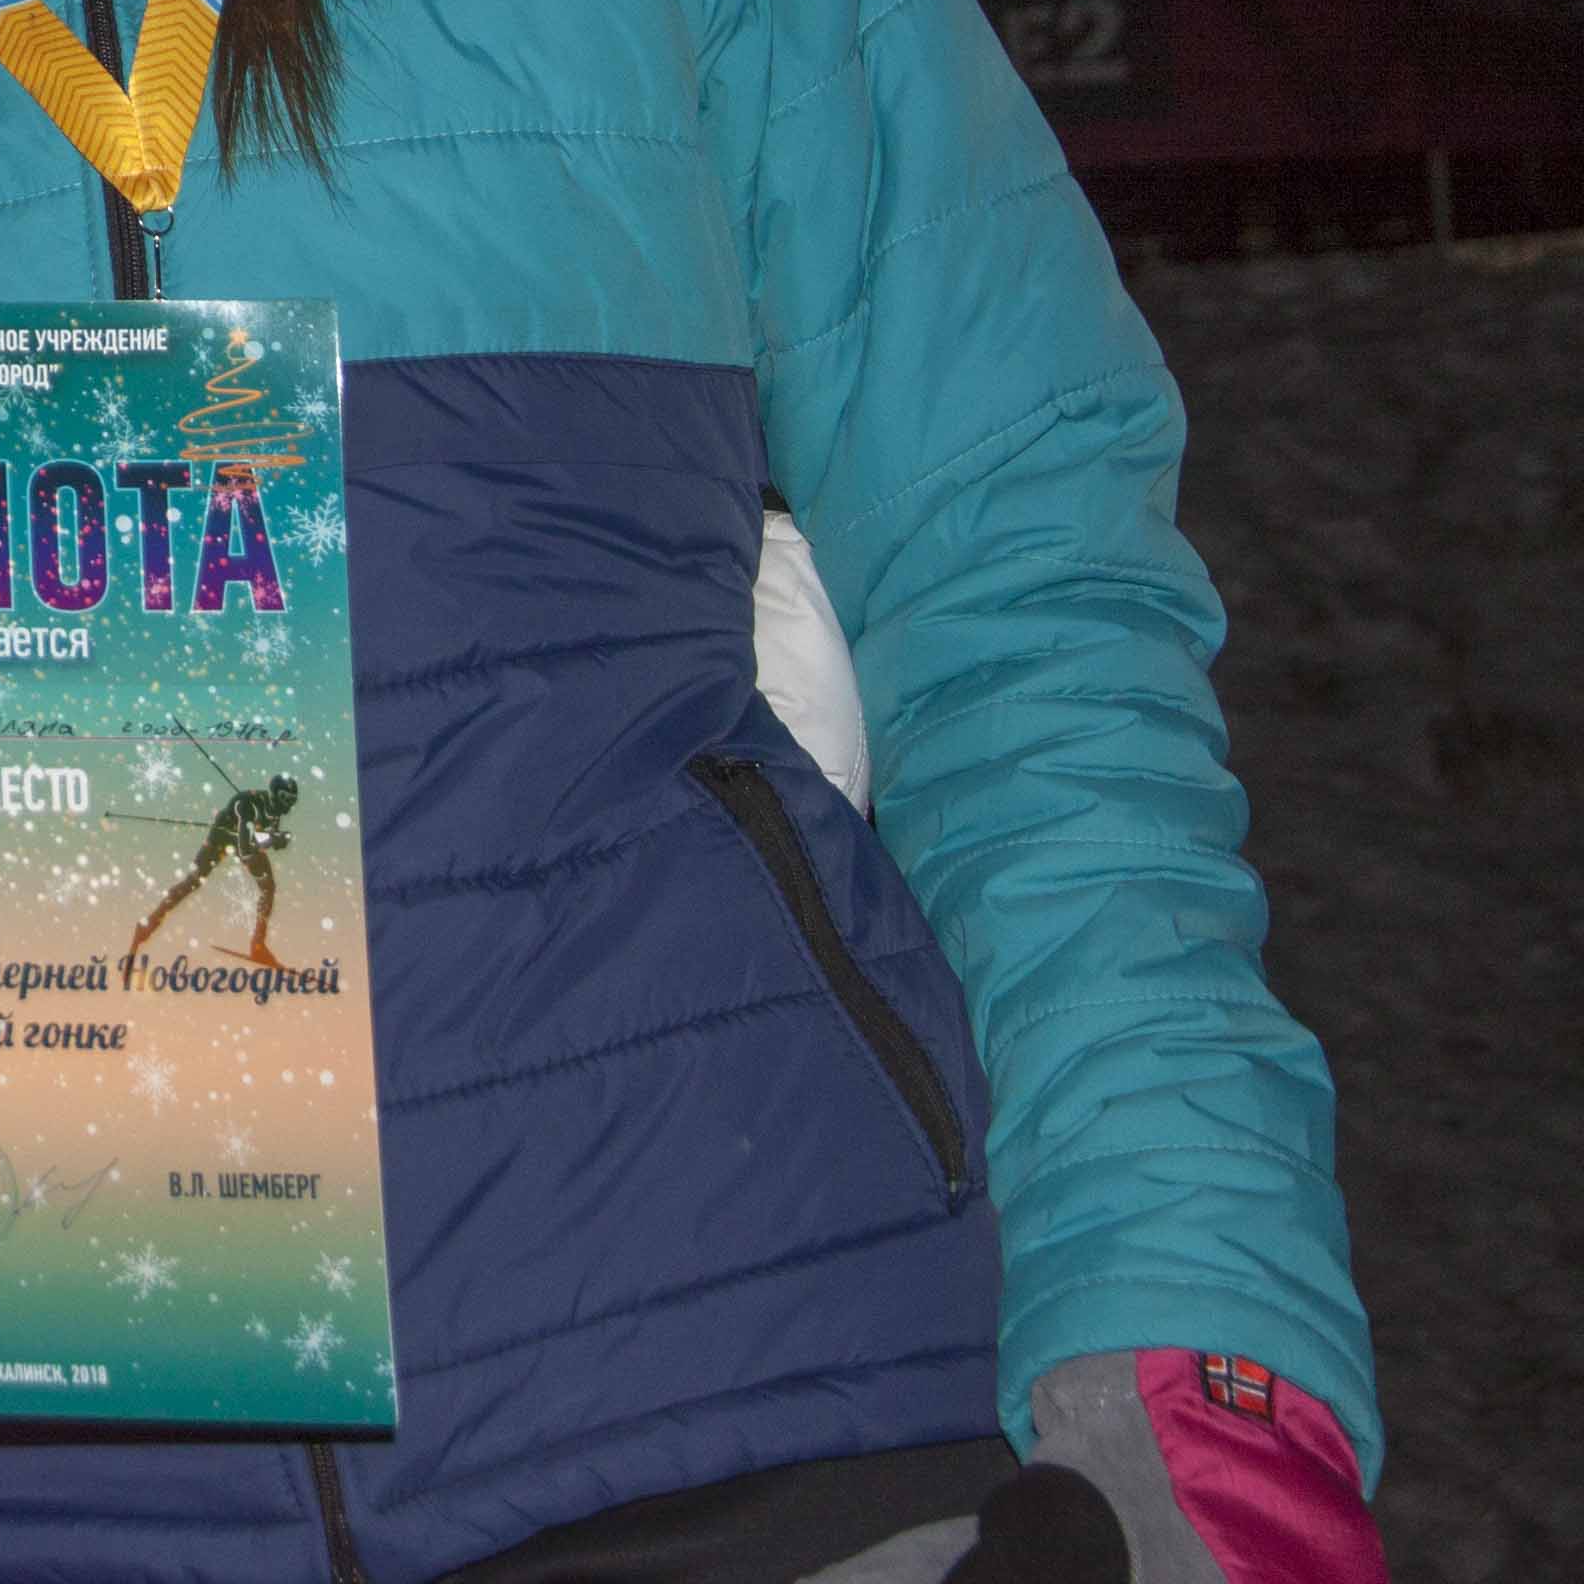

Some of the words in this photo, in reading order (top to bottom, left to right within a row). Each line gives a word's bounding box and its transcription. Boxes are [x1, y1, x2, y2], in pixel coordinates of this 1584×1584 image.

[35, 327, 168, 352] УЧРЕЖДЕНИЕ
[116, 953, 340, 1004] Новогодней
[24, 1021, 128, 1052] гонке
[169, 1171, 212, 1199] В.Л.
[217, 1172, 321, 1201] ШЕМБЕРГ
